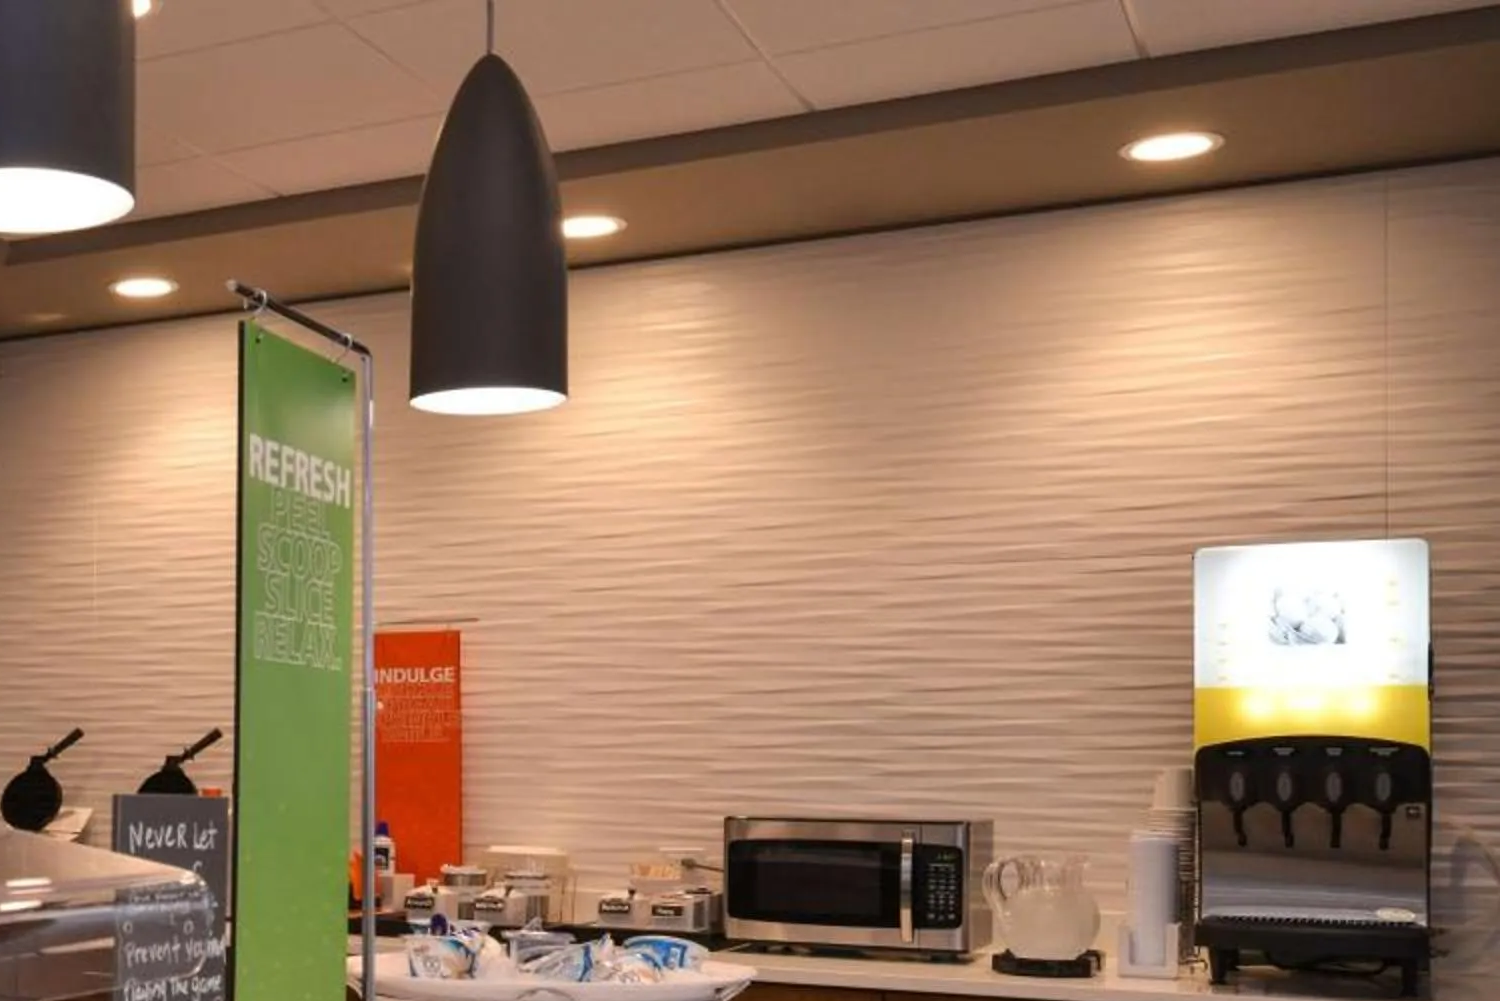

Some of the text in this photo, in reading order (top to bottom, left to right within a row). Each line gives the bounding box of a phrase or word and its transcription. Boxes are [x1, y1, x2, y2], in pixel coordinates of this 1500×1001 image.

[248, 432, 351, 509] REFRESH
[257, 521, 343, 581] SCOOP
[263, 571, 334, 627] SLICE
[375, 665, 455, 684] INDULGE
